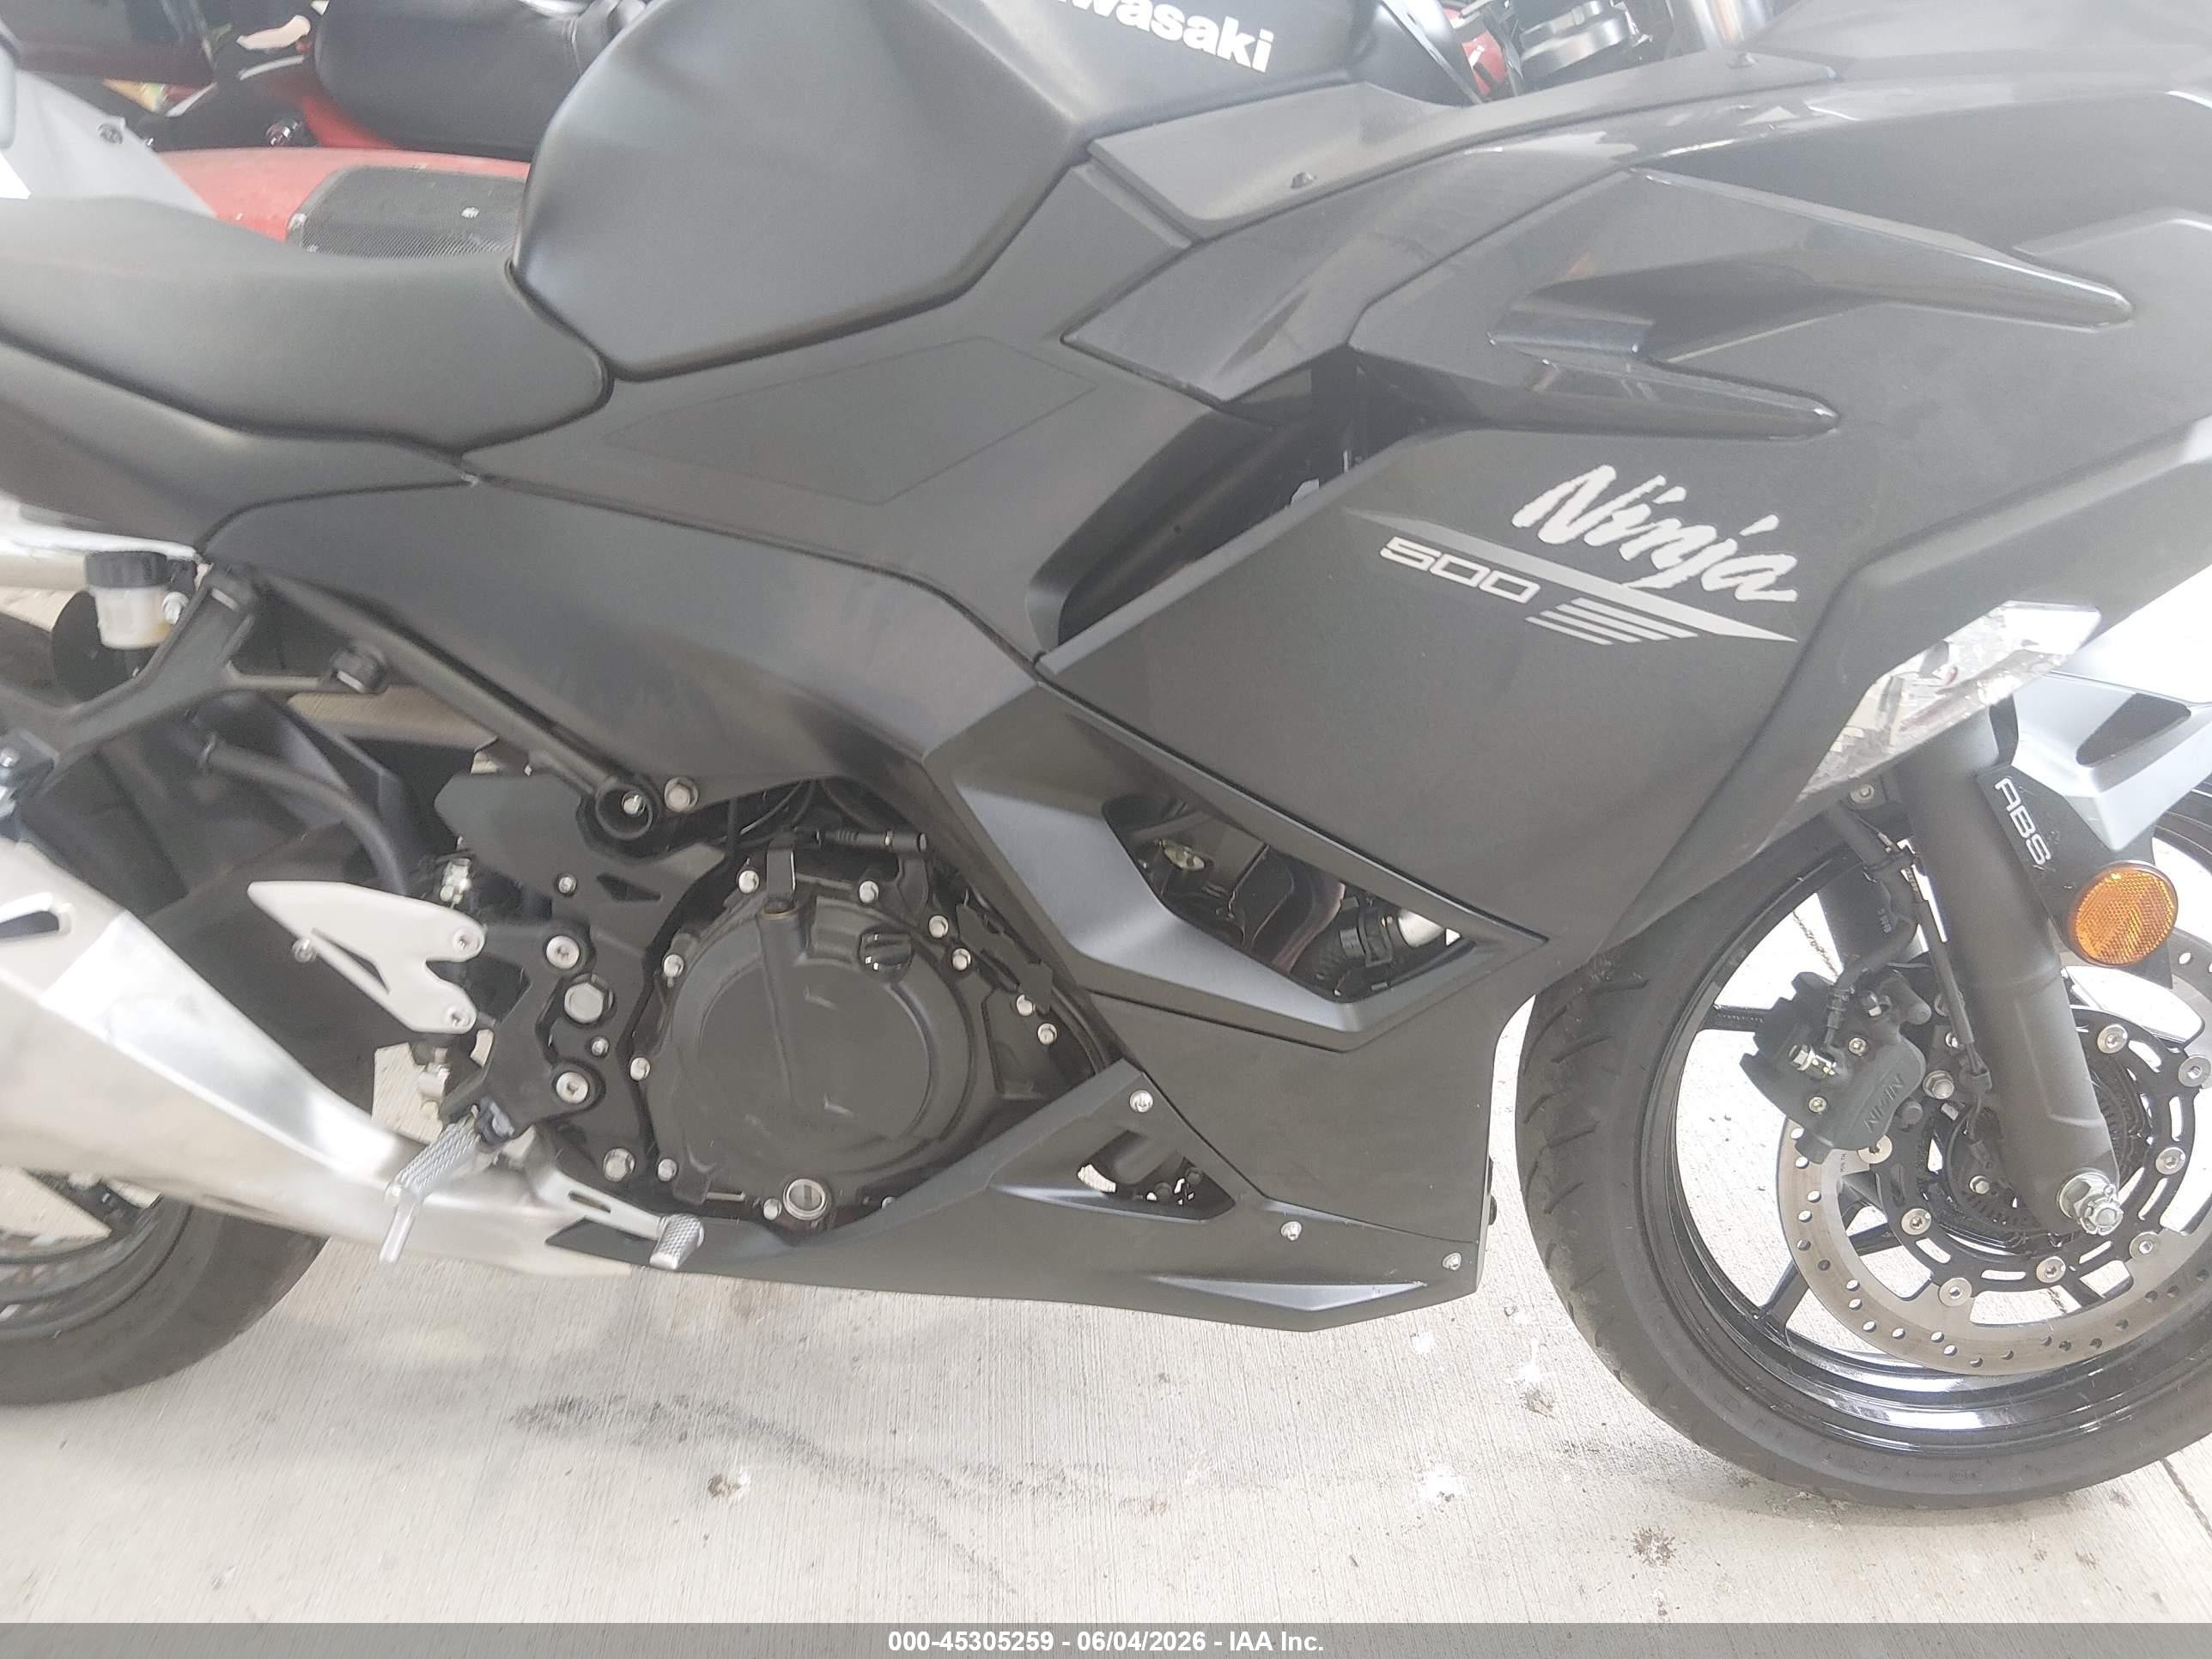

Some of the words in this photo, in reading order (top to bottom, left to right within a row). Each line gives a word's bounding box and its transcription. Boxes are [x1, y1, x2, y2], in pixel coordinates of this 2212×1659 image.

[1058, 0, 1274, 72] wasaki
[1380, 536, 1541, 604] 500
[1511, 465, 1797, 602] Ninja
[1995, 778, 2051, 865] ABS
